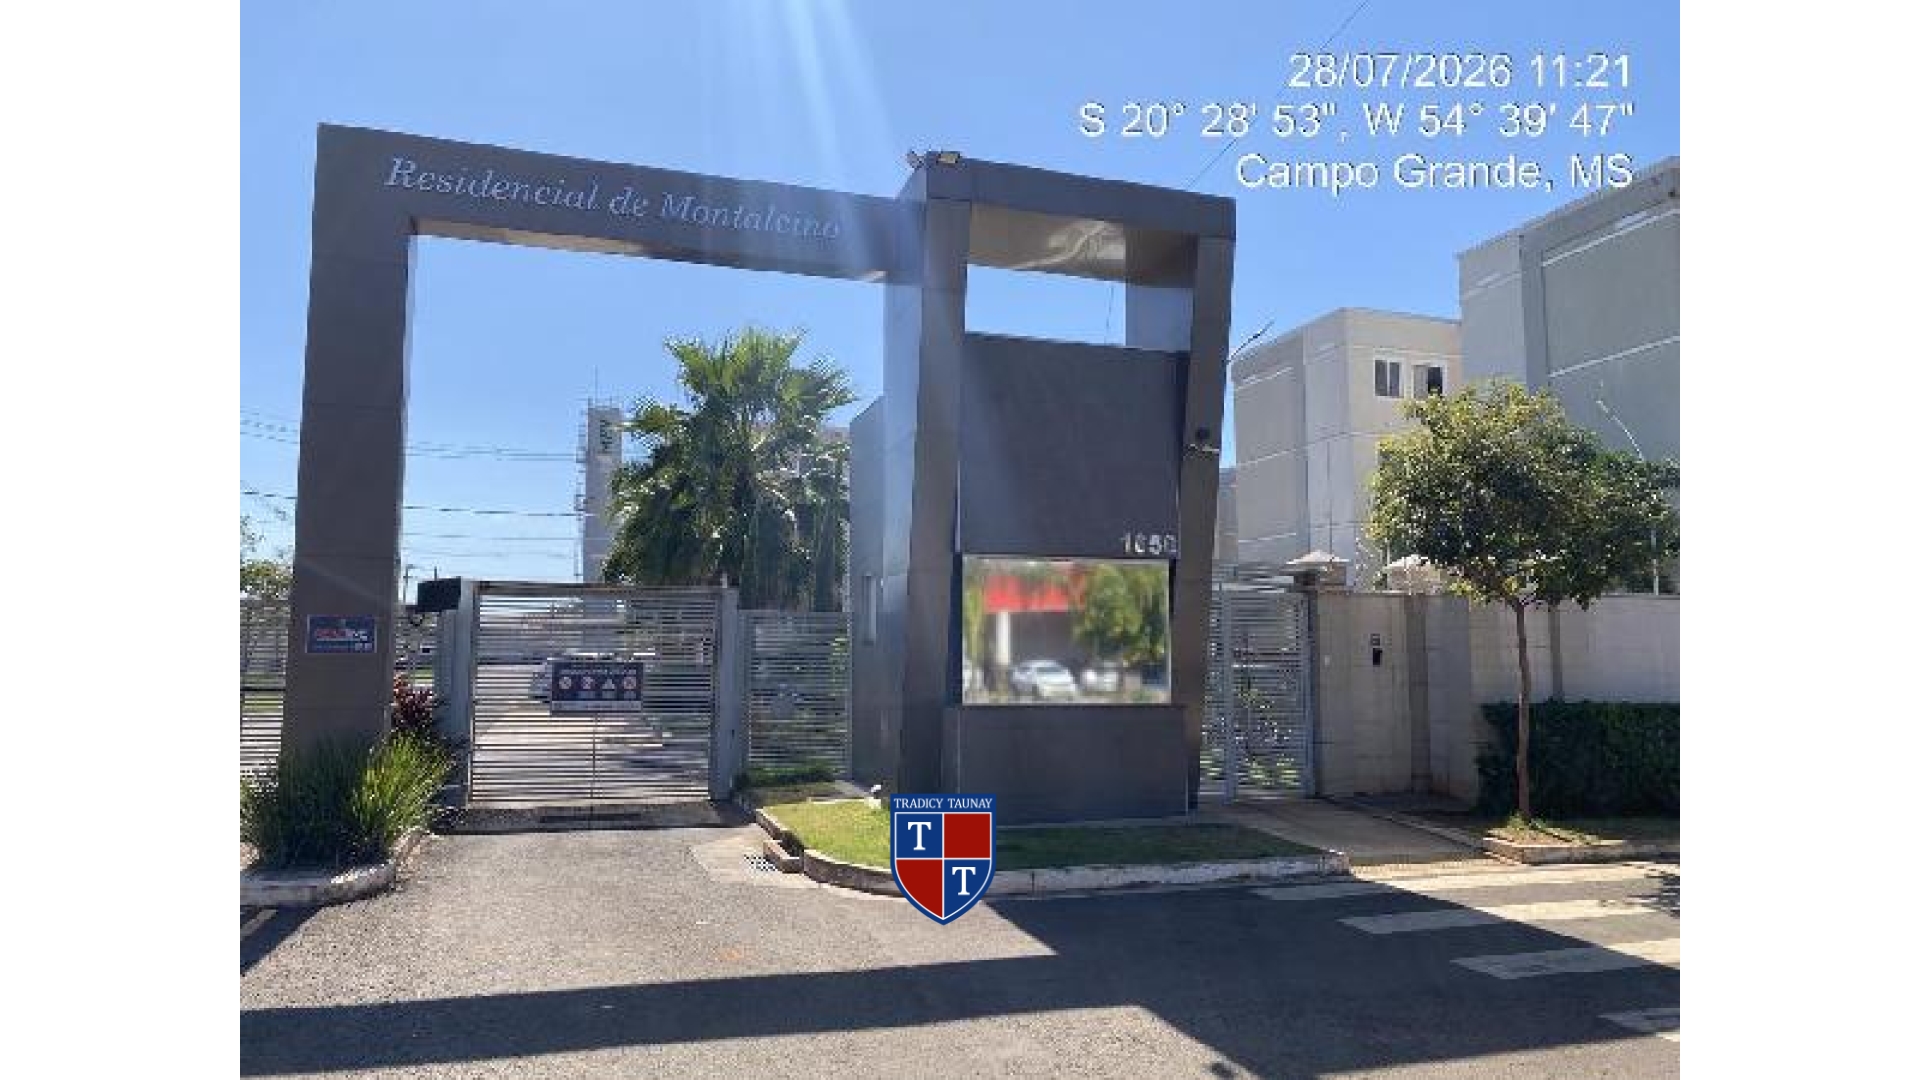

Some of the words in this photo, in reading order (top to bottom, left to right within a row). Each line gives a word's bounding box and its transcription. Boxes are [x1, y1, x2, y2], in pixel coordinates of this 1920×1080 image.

[383, 156, 600, 211] Residencial
[609, 186, 649, 218] de
[660, 191, 841, 240] Montalcino
